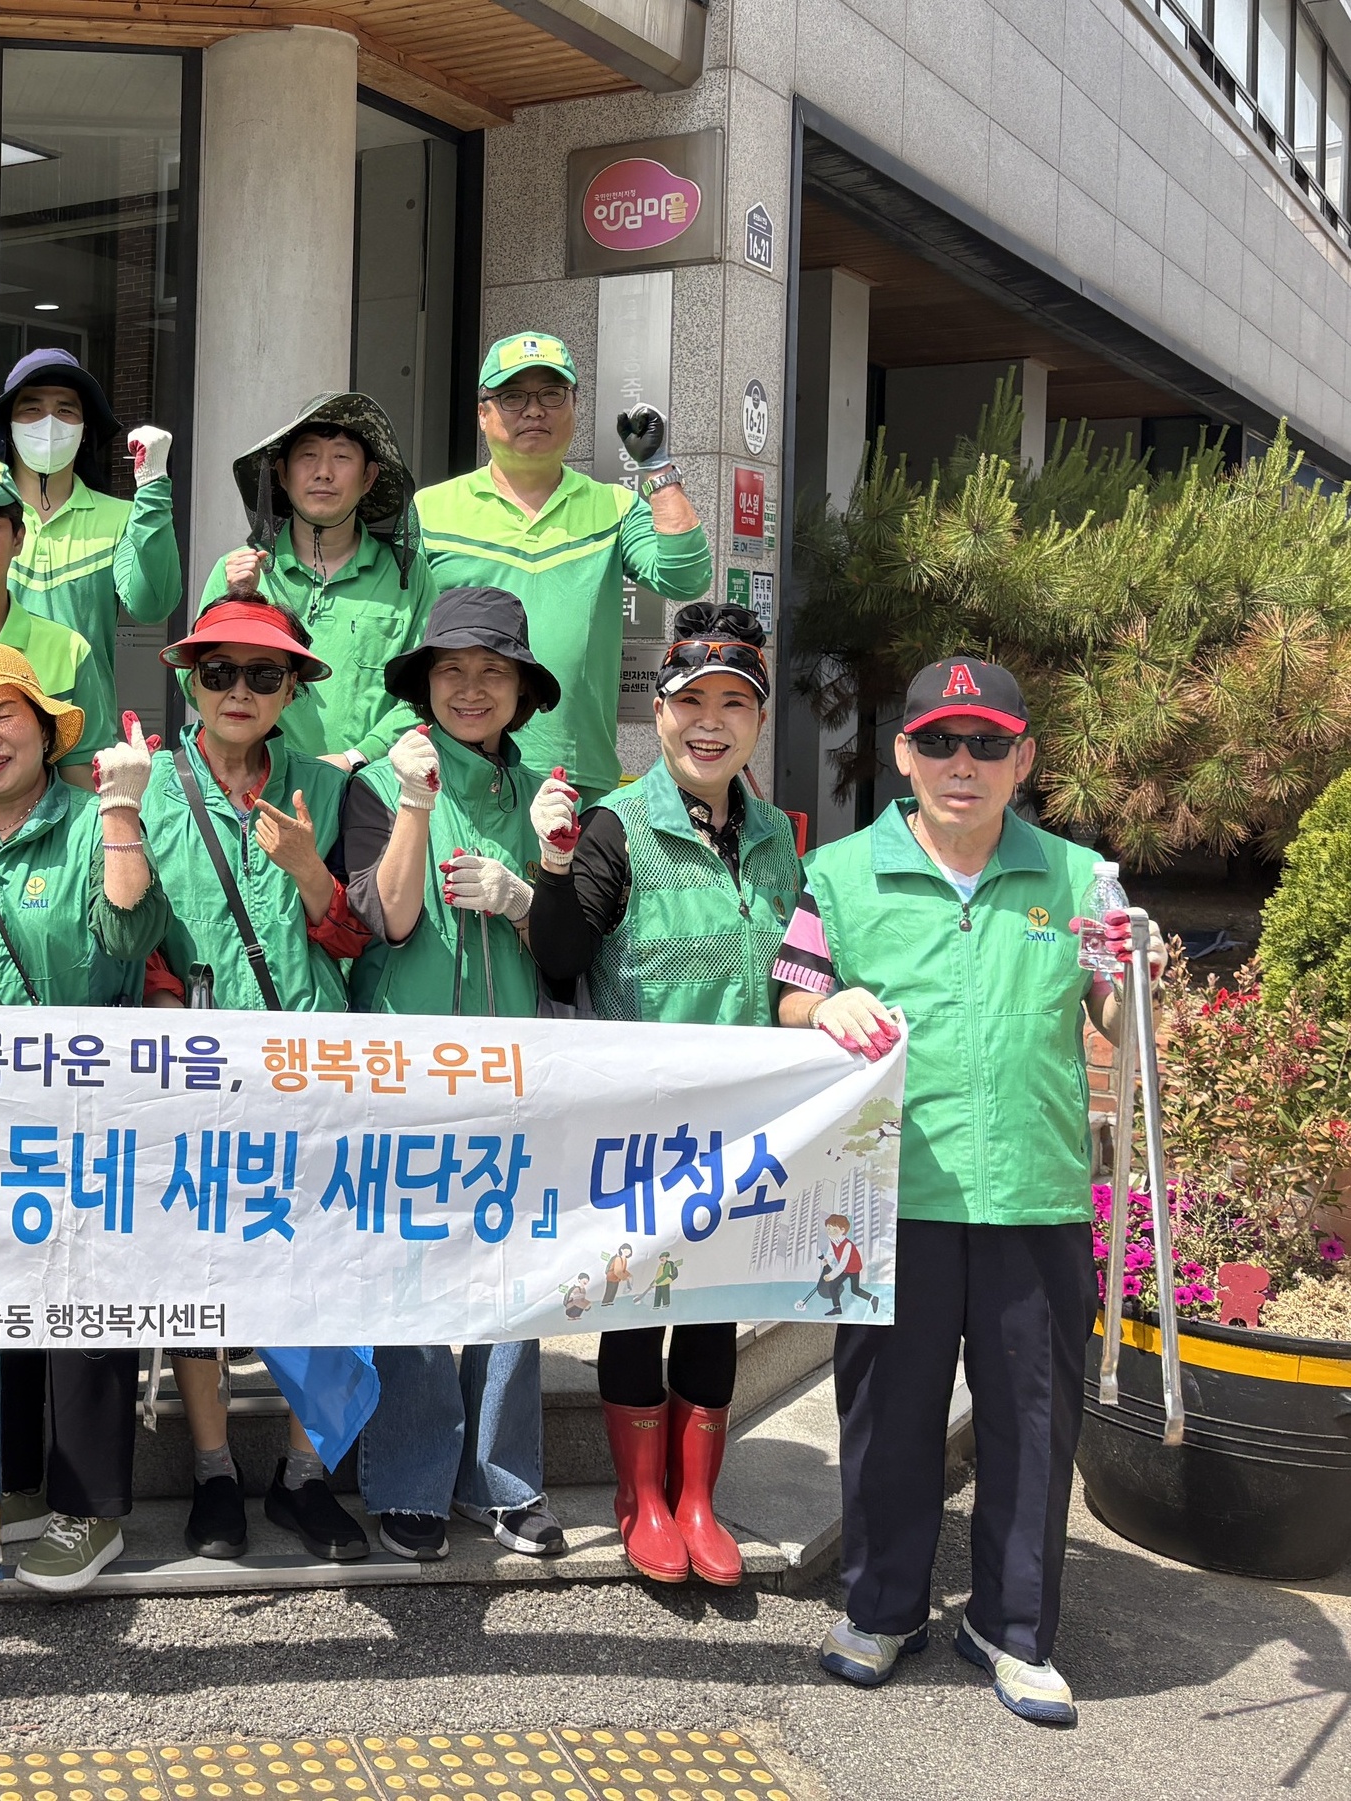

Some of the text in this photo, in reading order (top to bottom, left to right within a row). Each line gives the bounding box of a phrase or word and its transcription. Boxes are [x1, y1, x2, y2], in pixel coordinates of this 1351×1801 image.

[593, 189, 637, 202] 국민안전처지정
[593, 192, 689, 231] 안심마을
[749, 232, 770, 264] 16-21
[745, 407, 766, 436] 16-21
[738, 492, 760, 515] 에스원
[619, 683, 649, 693] 습센터
[620, 670, 658, 681] 민자치형
[942, 664, 981, 697] A
[21, 898, 49, 909] SMU
[1024, 930, 1056, 942] SMU
[130, 1035, 243, 1093] 마을,
[261, 1038, 411, 1094] 행복한
[427, 1042, 524, 1097] 우리
[160, 1130, 297, 1243] 새빛
[319, 1133, 558, 1243] 새단장』
[589, 1123, 787, 1242] 대청소
[46, 1303, 226, 1339] 행정복지센터
